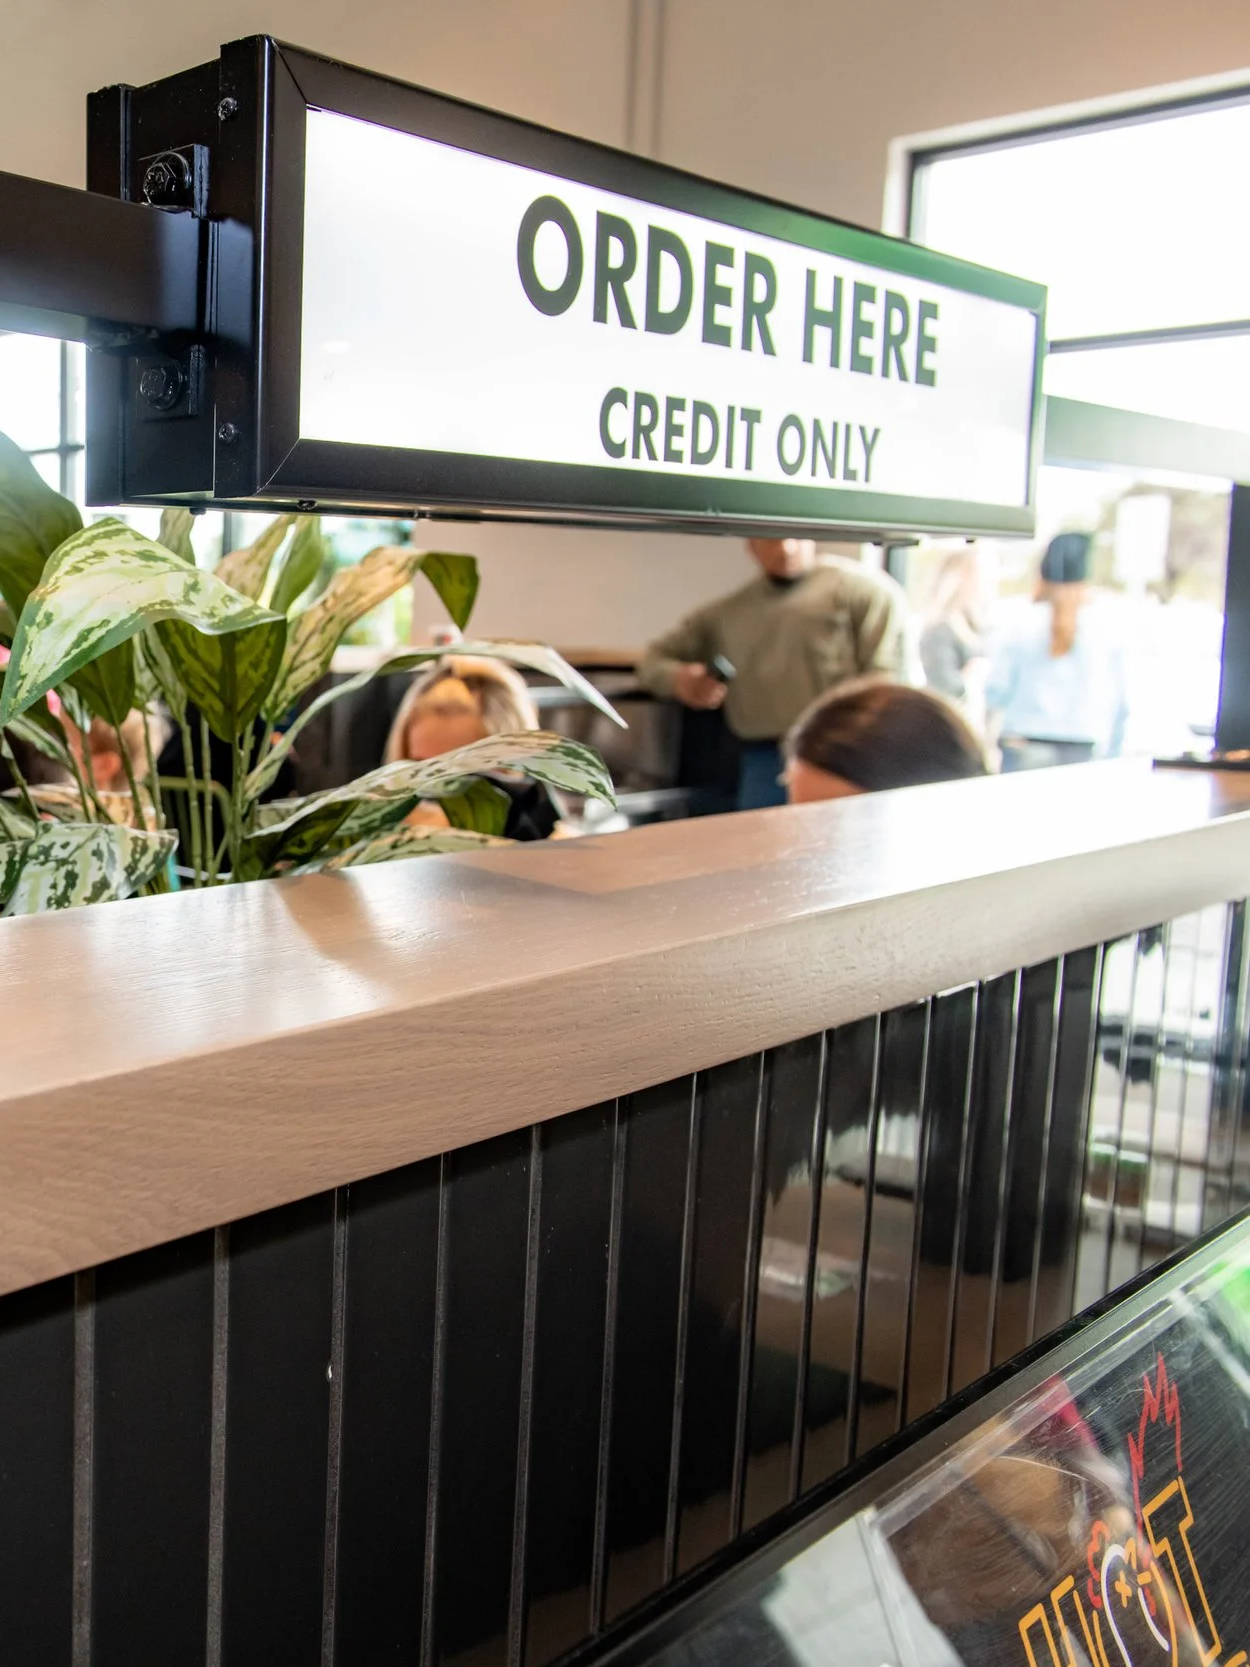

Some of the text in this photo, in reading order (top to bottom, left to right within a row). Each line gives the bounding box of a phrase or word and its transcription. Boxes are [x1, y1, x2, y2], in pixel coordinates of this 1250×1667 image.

[517, 195, 939, 387] ORDER HERE
[599, 386, 881, 482] CREDIT ONLY
